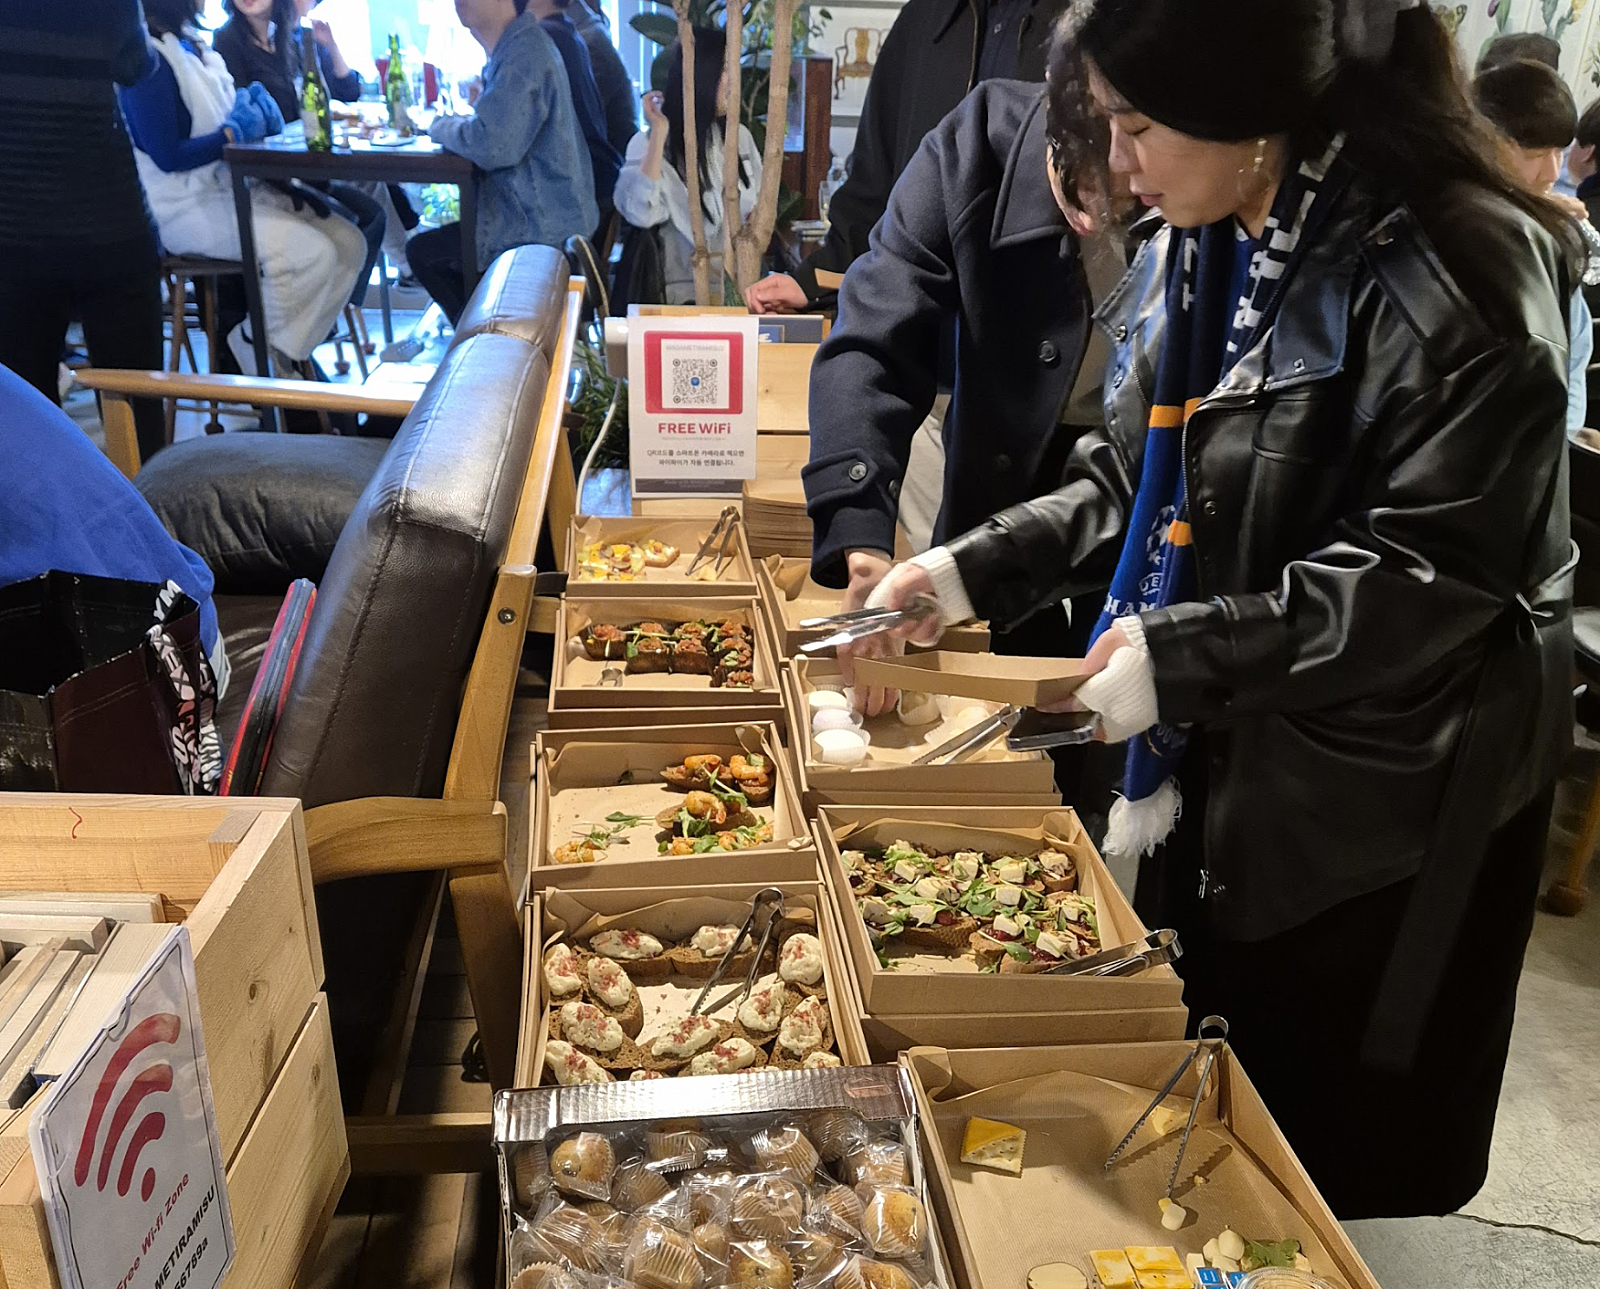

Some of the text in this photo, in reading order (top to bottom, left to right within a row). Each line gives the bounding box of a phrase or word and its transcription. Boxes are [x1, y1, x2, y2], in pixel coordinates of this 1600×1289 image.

[658, 422, 731, 434] FREE WiFi
[116, 1256, 141, 1289] Free
[164, 1173, 189, 1217] Zone
